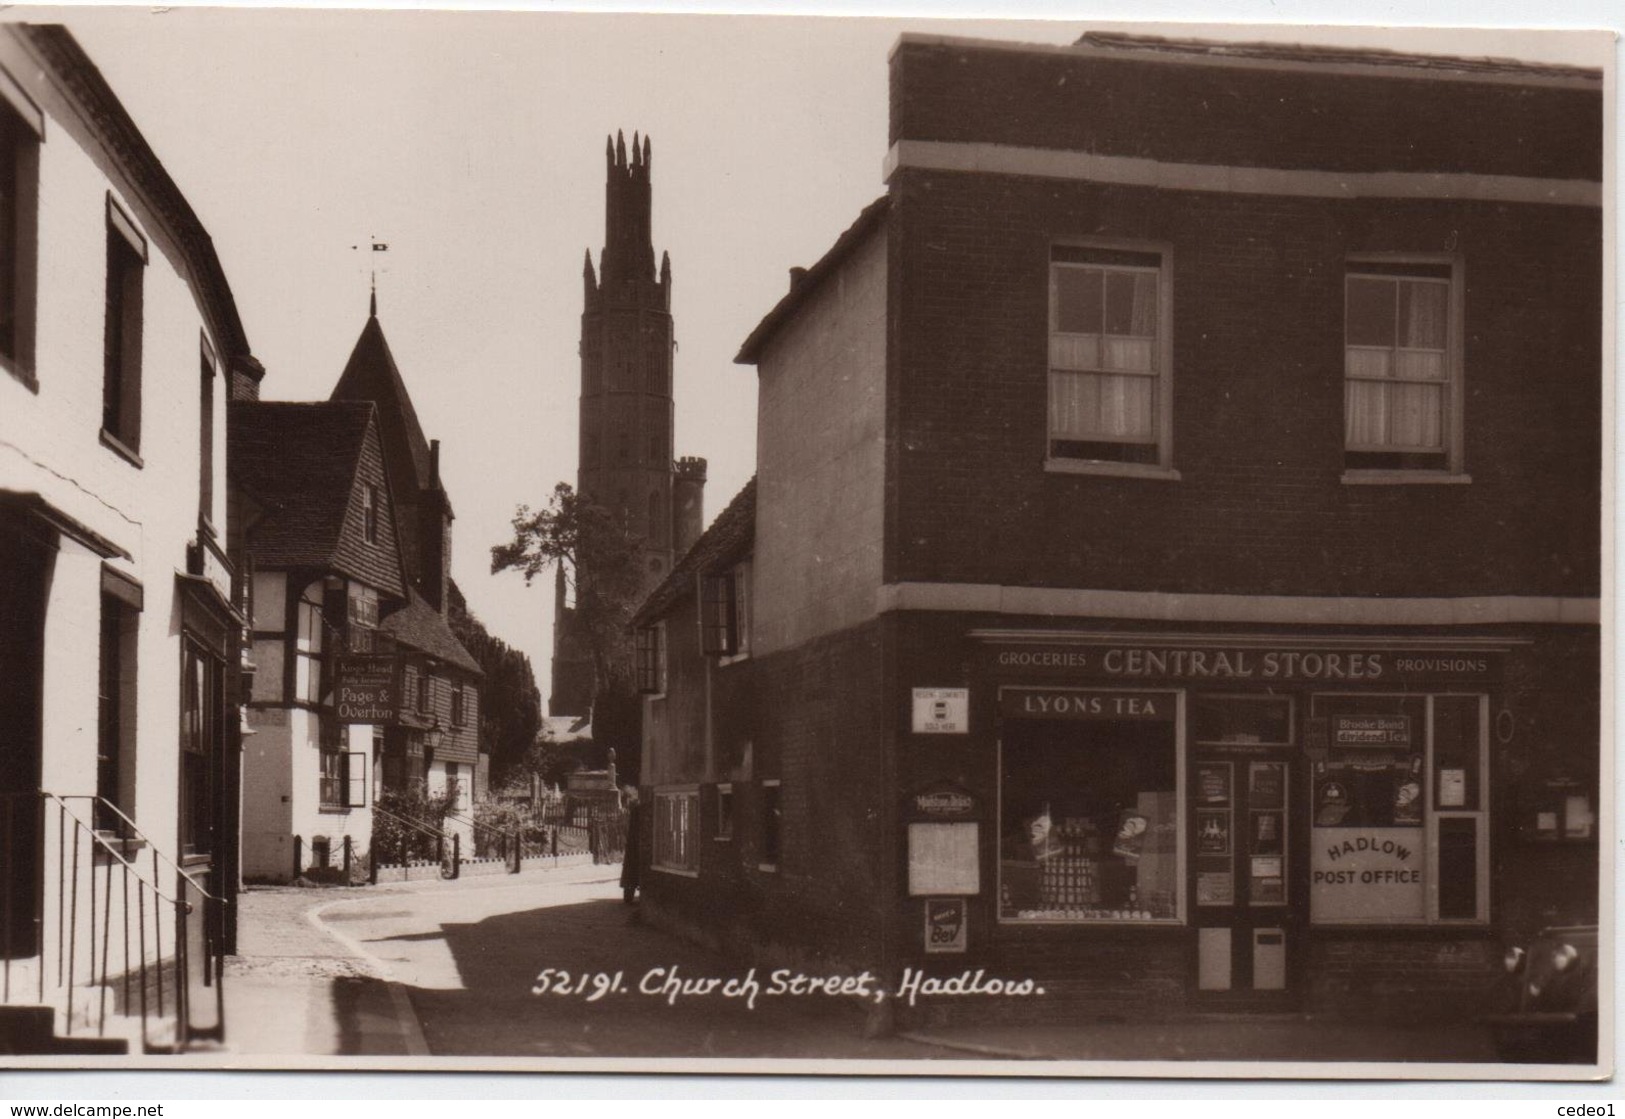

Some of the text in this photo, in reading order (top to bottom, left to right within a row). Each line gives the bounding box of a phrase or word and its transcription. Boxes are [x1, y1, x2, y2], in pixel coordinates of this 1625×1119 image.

[1000, 649, 1487, 679] GROCERIES CENTRAL STORES PROVISIONS
[342, 687, 390, 706] Page &
[339, 703, 393, 719] Overton
[1025, 696, 1156, 715] LYONS TEA
[1340, 720, 1404, 730] Brooke Bond
[1389, 730, 1407, 742] Tea
[1327, 837, 1412, 861] HADLOW
[1314, 870, 1421, 884] POST OFFICE
